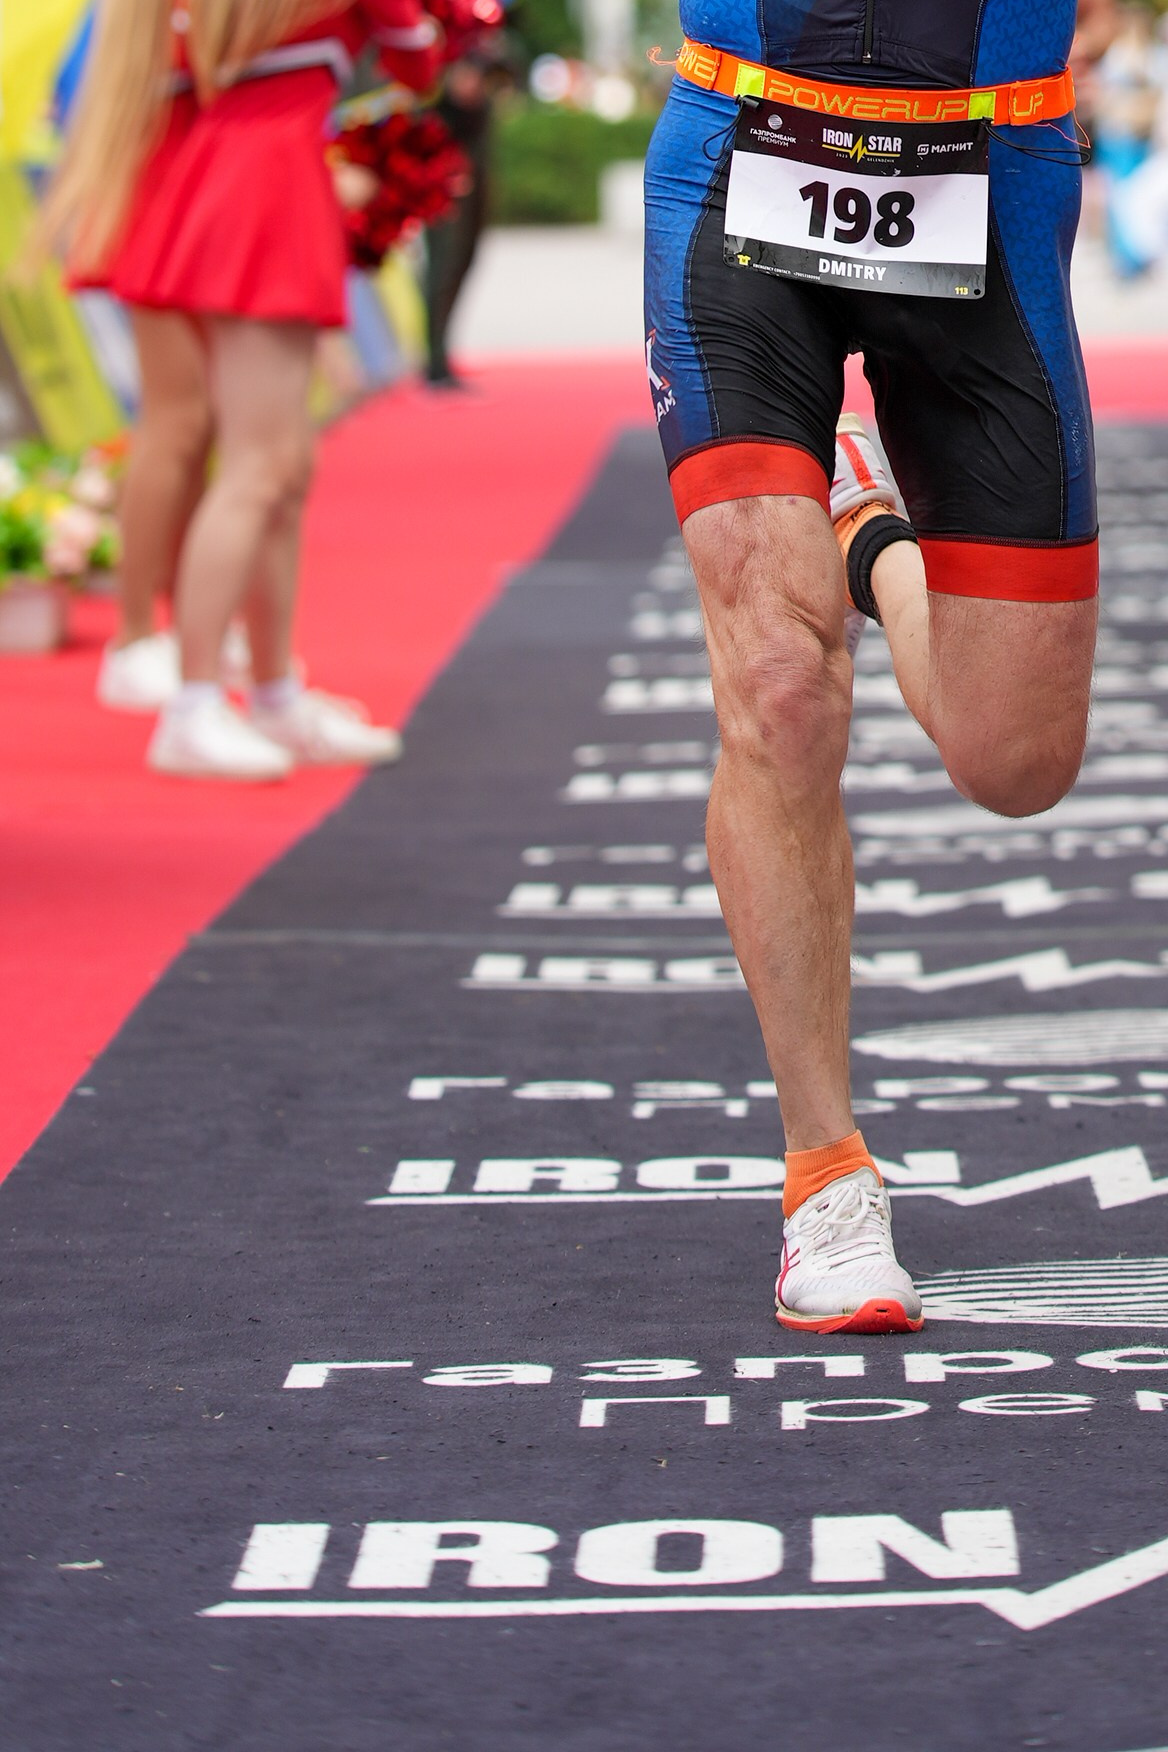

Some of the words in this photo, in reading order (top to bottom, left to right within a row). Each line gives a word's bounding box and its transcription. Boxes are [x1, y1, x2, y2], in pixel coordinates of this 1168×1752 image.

[767, 78, 969, 121] POWERUP
[1012, 91, 1044, 117] UP
[749, 128, 797, 144] ГАЗПРОМБАНК
[757, 135, 789, 148] ПРЕМИУМ
[822, 127, 853, 148] IRON
[867, 135, 903, 152] STAR
[931, 141, 974, 154] МАГНИТ
[798, 179, 916, 248] 198
[818, 258, 887, 282] DMITRY
[954, 286, 969, 296] 113
[388, 1148, 963, 1196] IRON
[231, 1508, 1021, 1592] IRON
